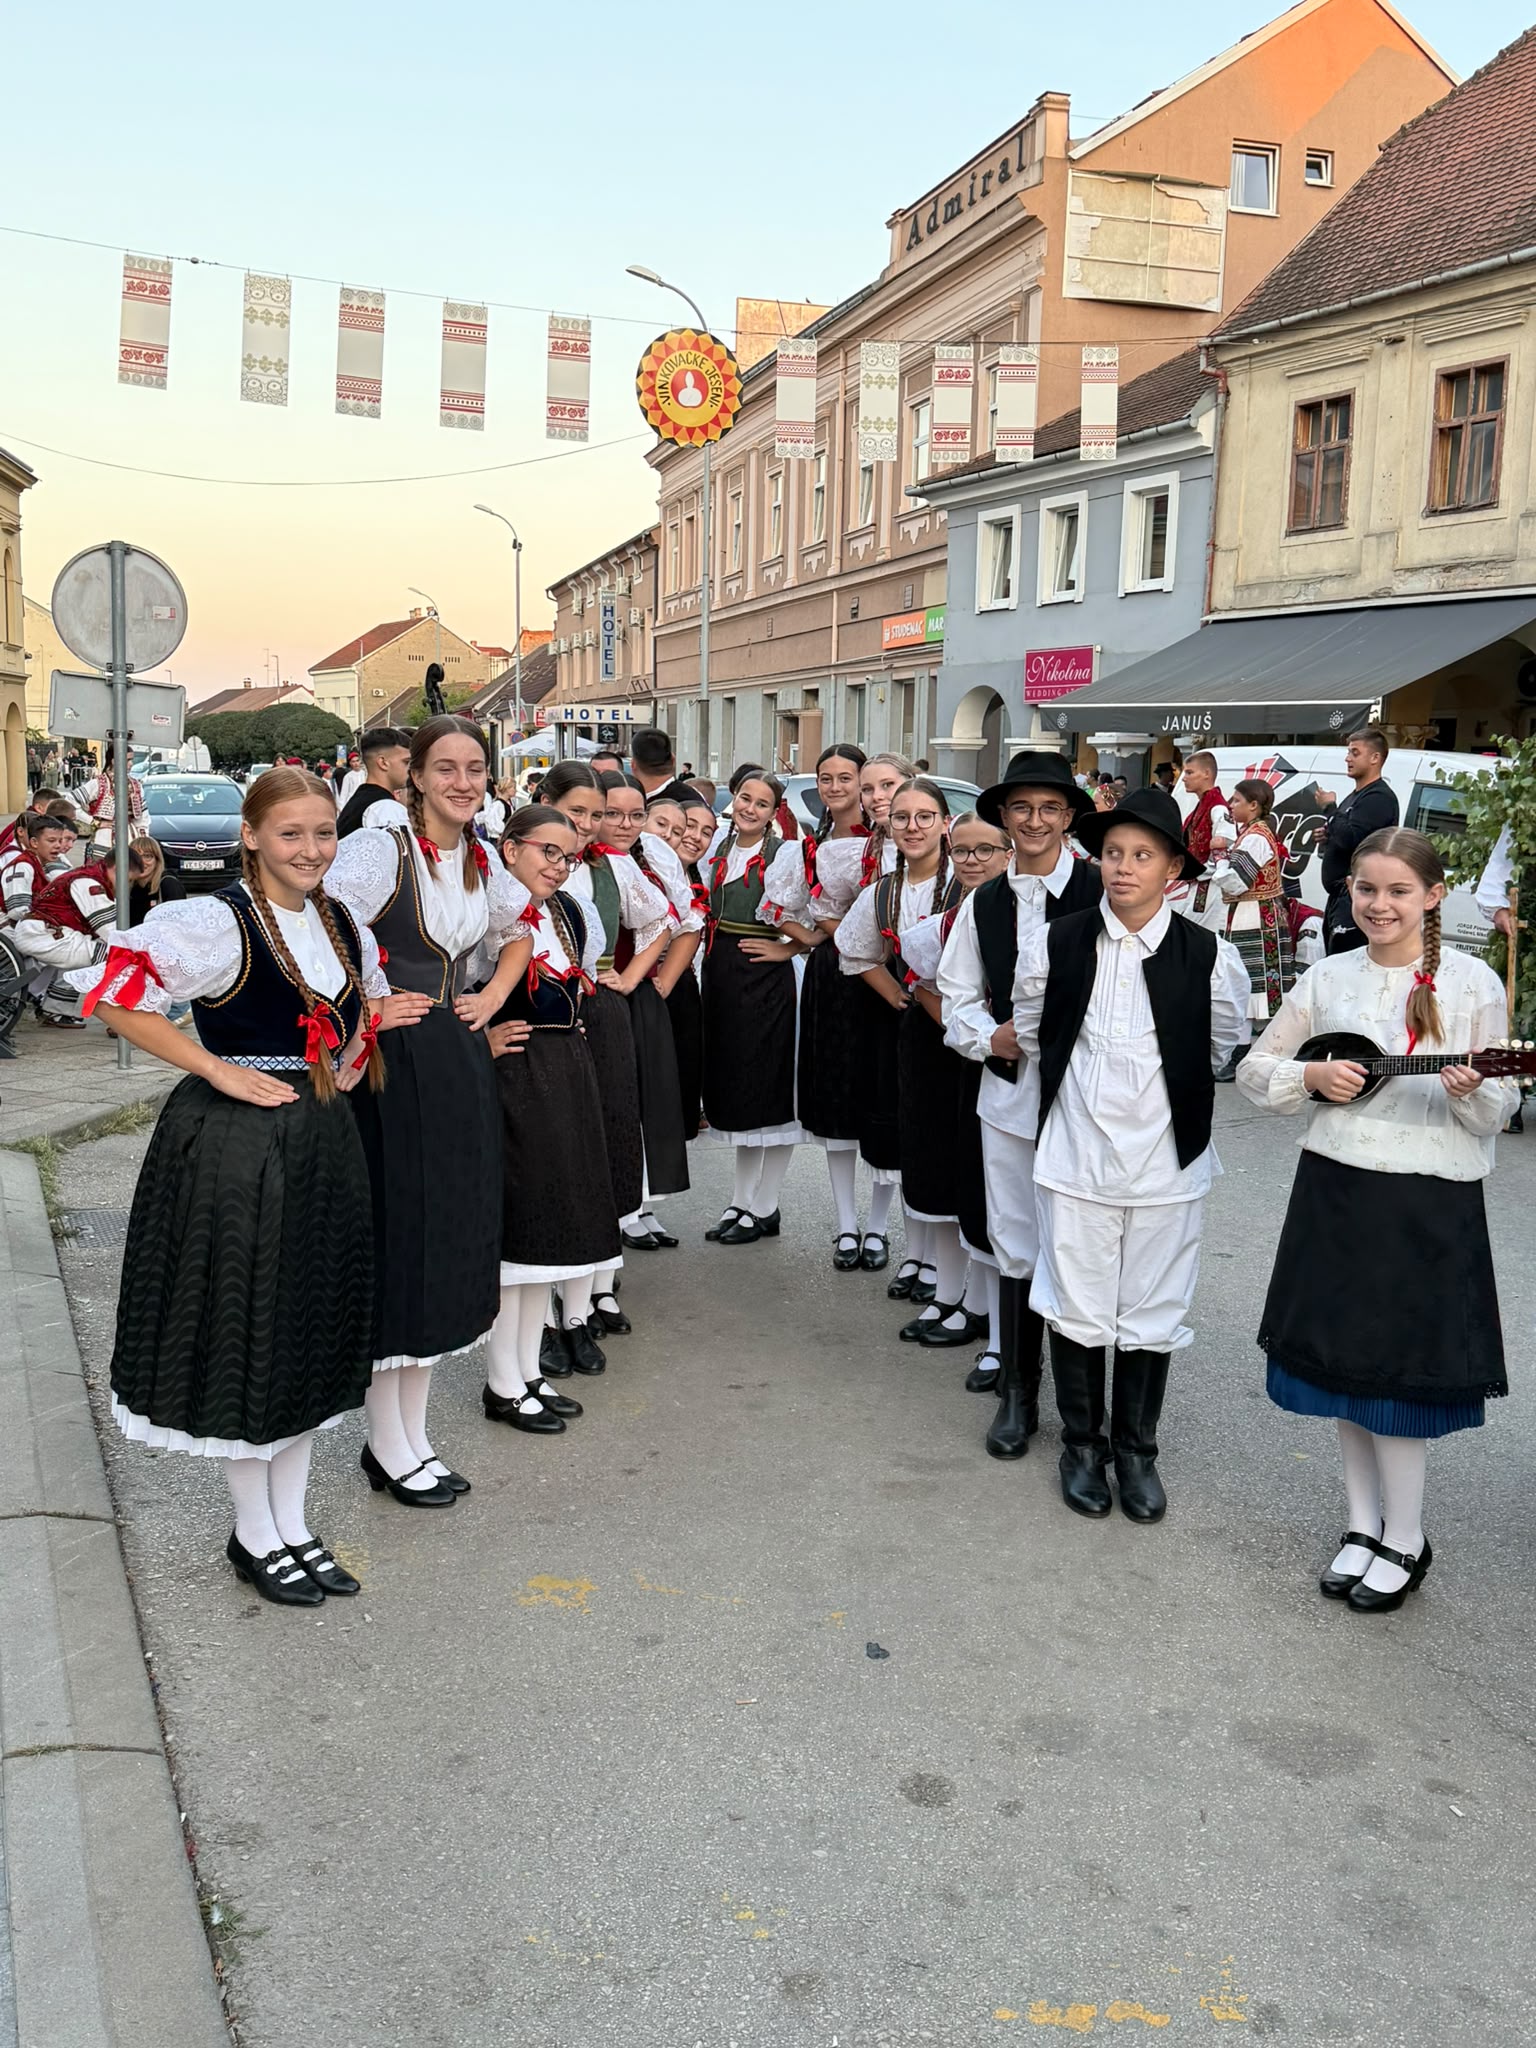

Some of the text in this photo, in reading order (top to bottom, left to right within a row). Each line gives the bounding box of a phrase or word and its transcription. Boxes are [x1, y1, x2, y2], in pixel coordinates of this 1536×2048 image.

[906, 130, 1026, 251] Admiral
[705, 365, 723, 407] JESENI
[603, 606, 614, 675] HOTEL
[891, 620, 923, 640] STUDENAC
[1026, 656, 1091, 683] Nikolina
[1026, 688, 1062, 698] WEDDING
[564, 708, 634, 721] HOTEL
[1161, 711, 1212, 731] JANUŠ
